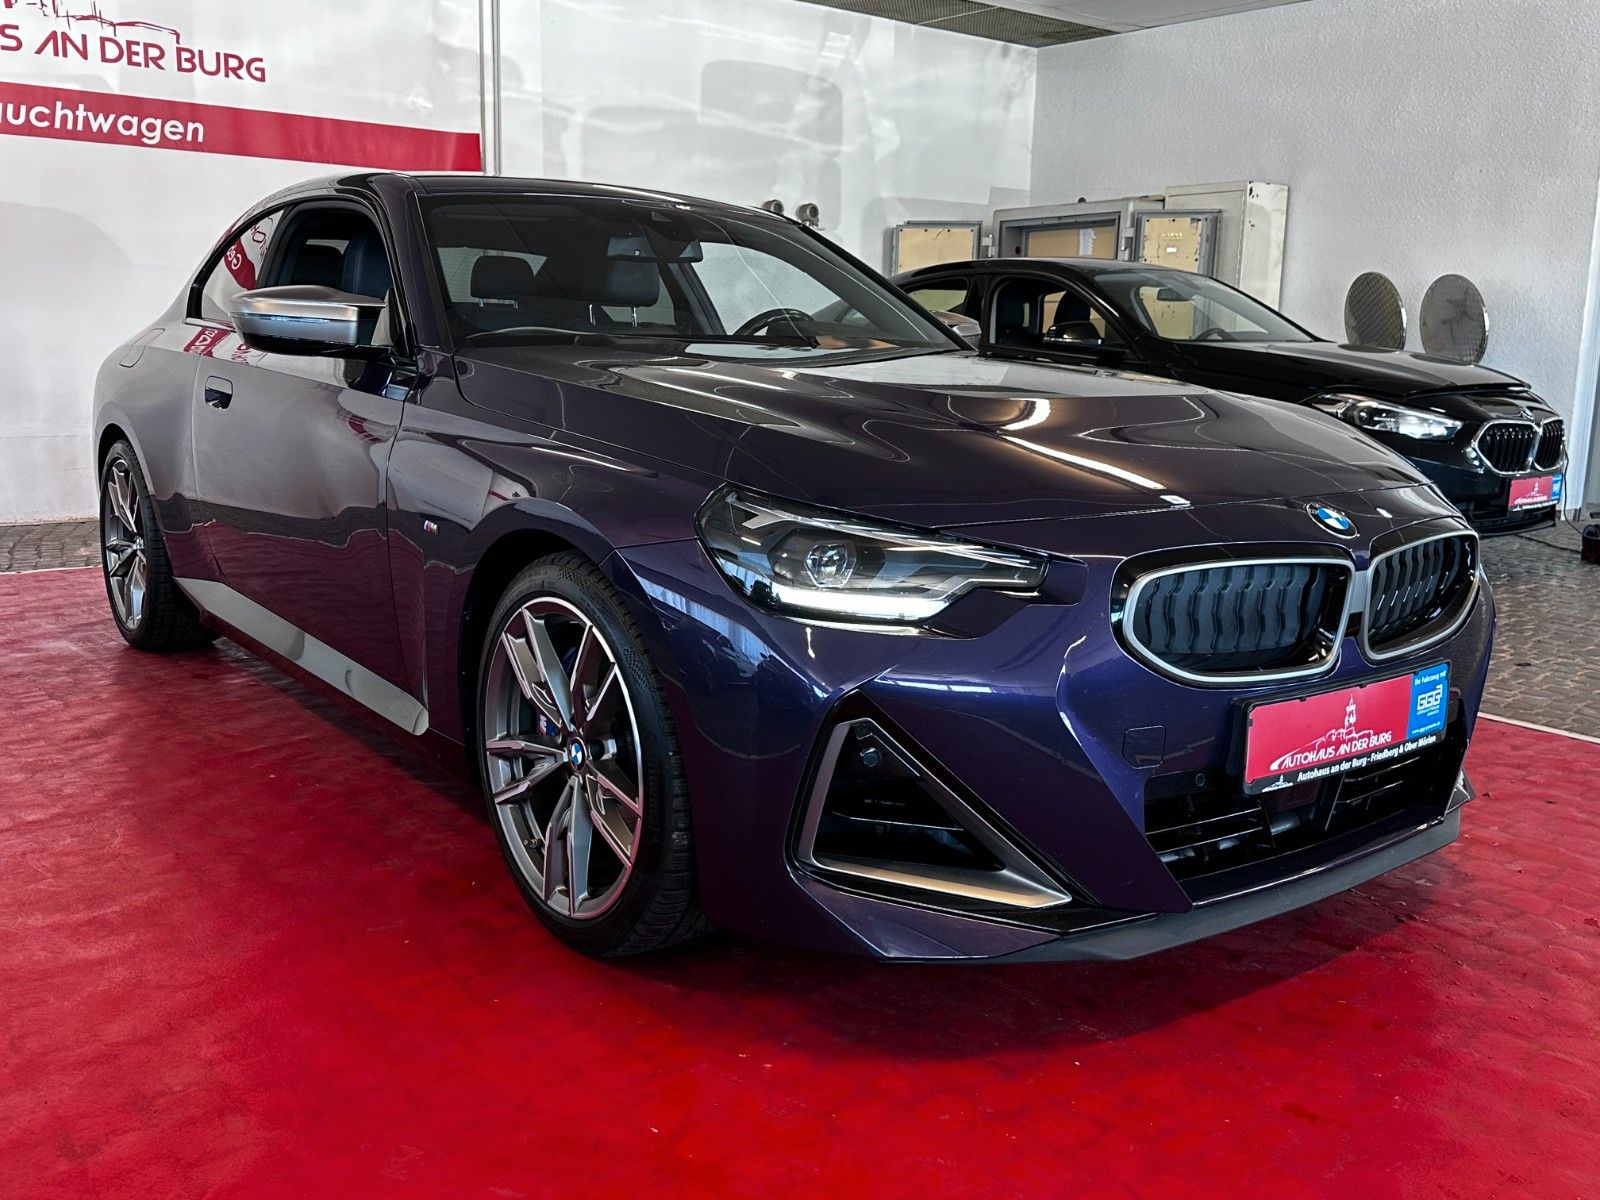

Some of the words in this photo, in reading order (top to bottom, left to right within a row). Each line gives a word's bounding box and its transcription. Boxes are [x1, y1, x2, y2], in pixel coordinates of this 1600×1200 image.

[33, 30, 88, 61] AN
[99, 36, 166, 71] DER
[176, 46, 267, 83] BURG
[0, 101, 205, 145] uchtwagen
[1281, 746, 1335, 769] AUTOHAUS
[1336, 742, 1351, 756] AN
[1351, 737, 1368, 752] DER
[1369, 730, 1392, 748] BURG
[1297, 766, 1330, 782] Autohaus
[1331, 763, 1340, 773] an
[1340, 760, 1352, 771] der
[1352, 756, 1367, 767] Burg
[1370, 747, 1398, 762] Friedberg
[1404, 741, 1418, 752] Ober
